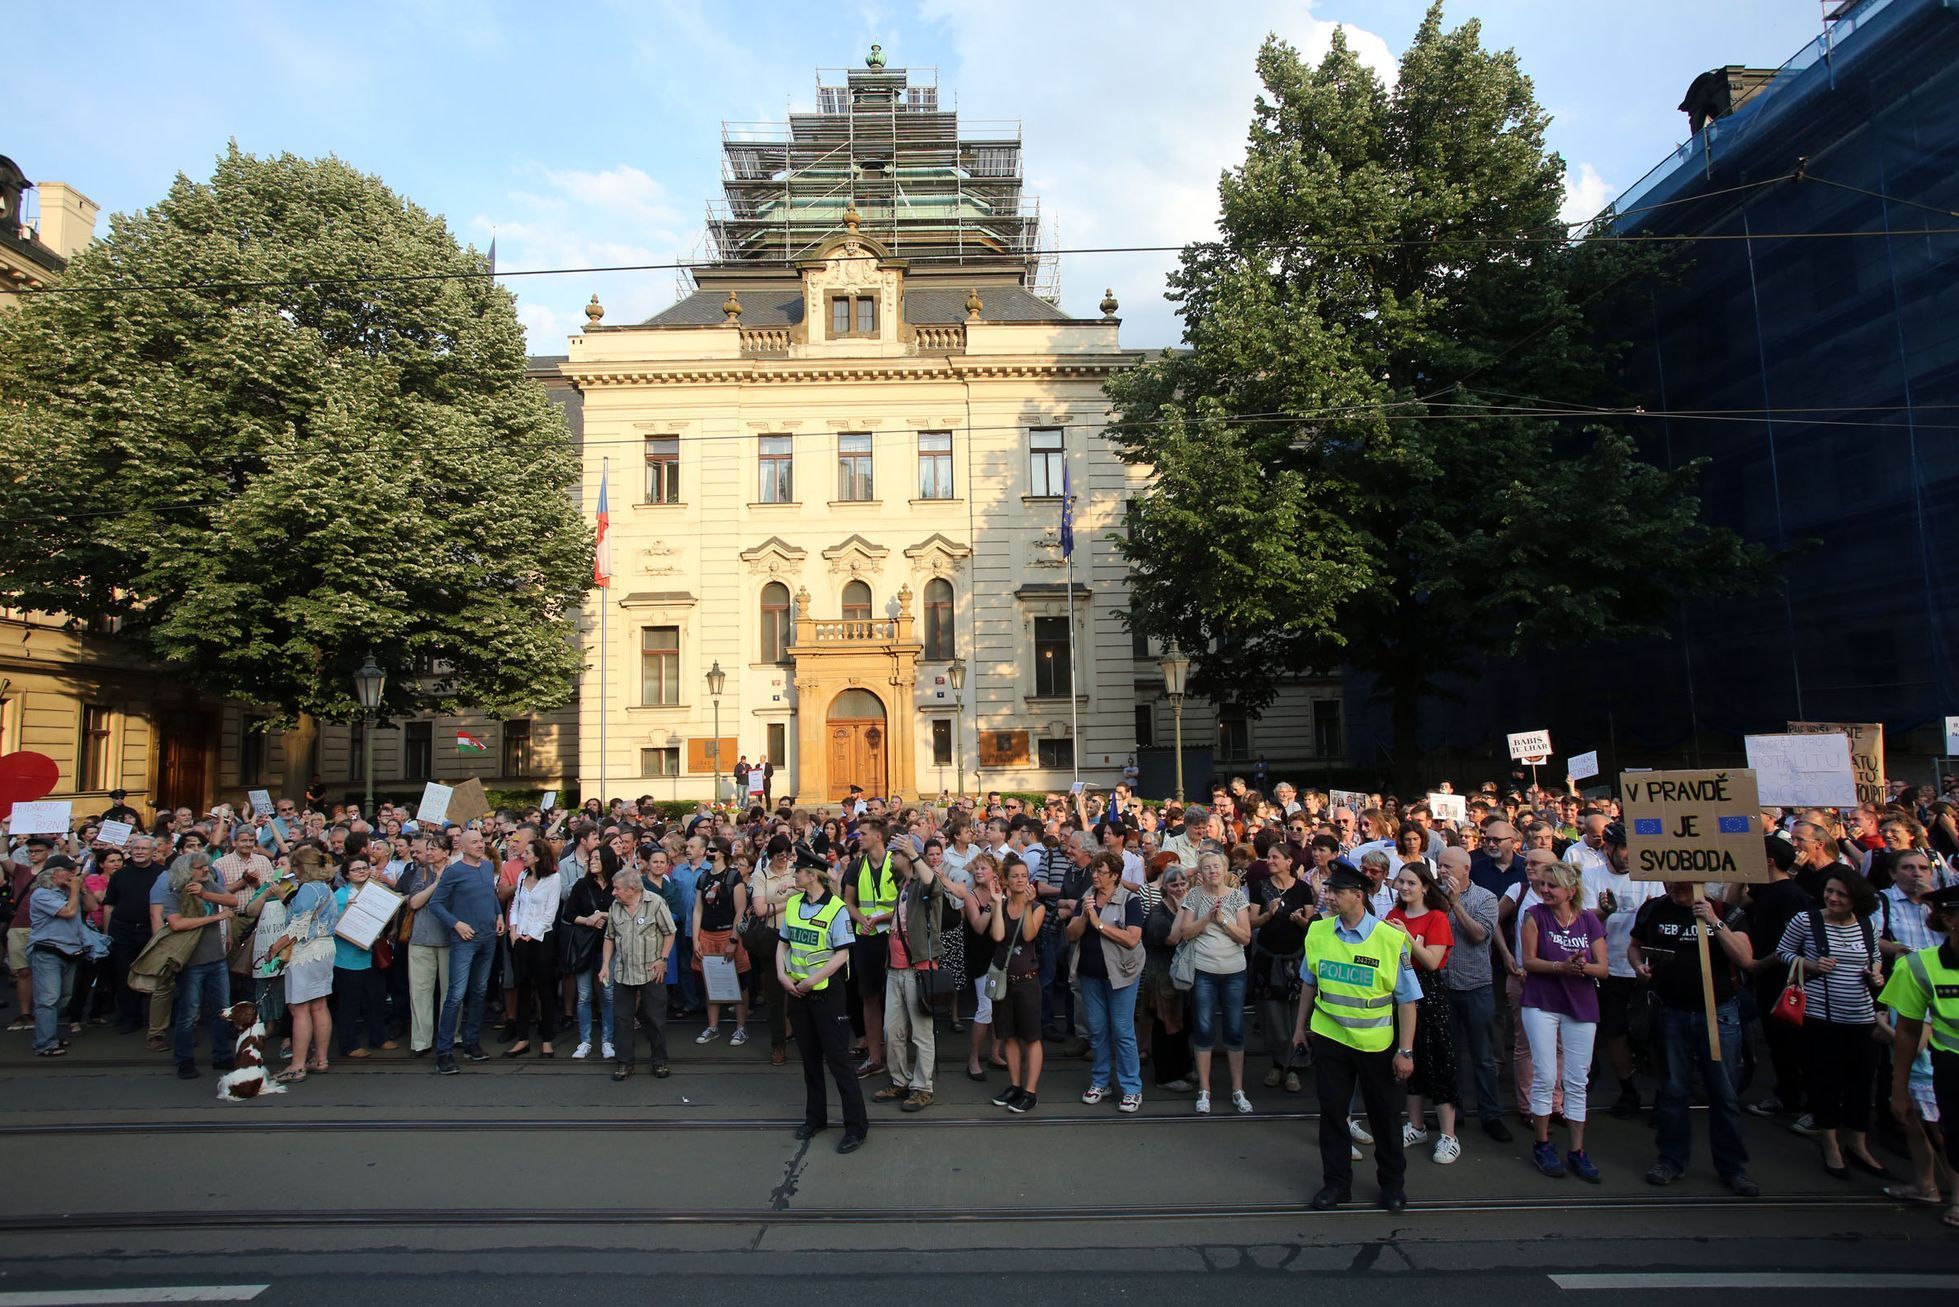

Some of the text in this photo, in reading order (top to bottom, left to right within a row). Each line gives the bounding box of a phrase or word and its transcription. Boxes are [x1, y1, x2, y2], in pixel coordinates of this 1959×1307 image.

[1511, 746, 1521, 754] JE
[1625, 772, 1732, 802] V PRAVDĚ
[1672, 815, 1701, 838] JE
[1640, 849, 1737, 872] SVOBODA
[790, 928, 818, 944] LICIE
[1319, 962, 1372, 984] POLICIE
